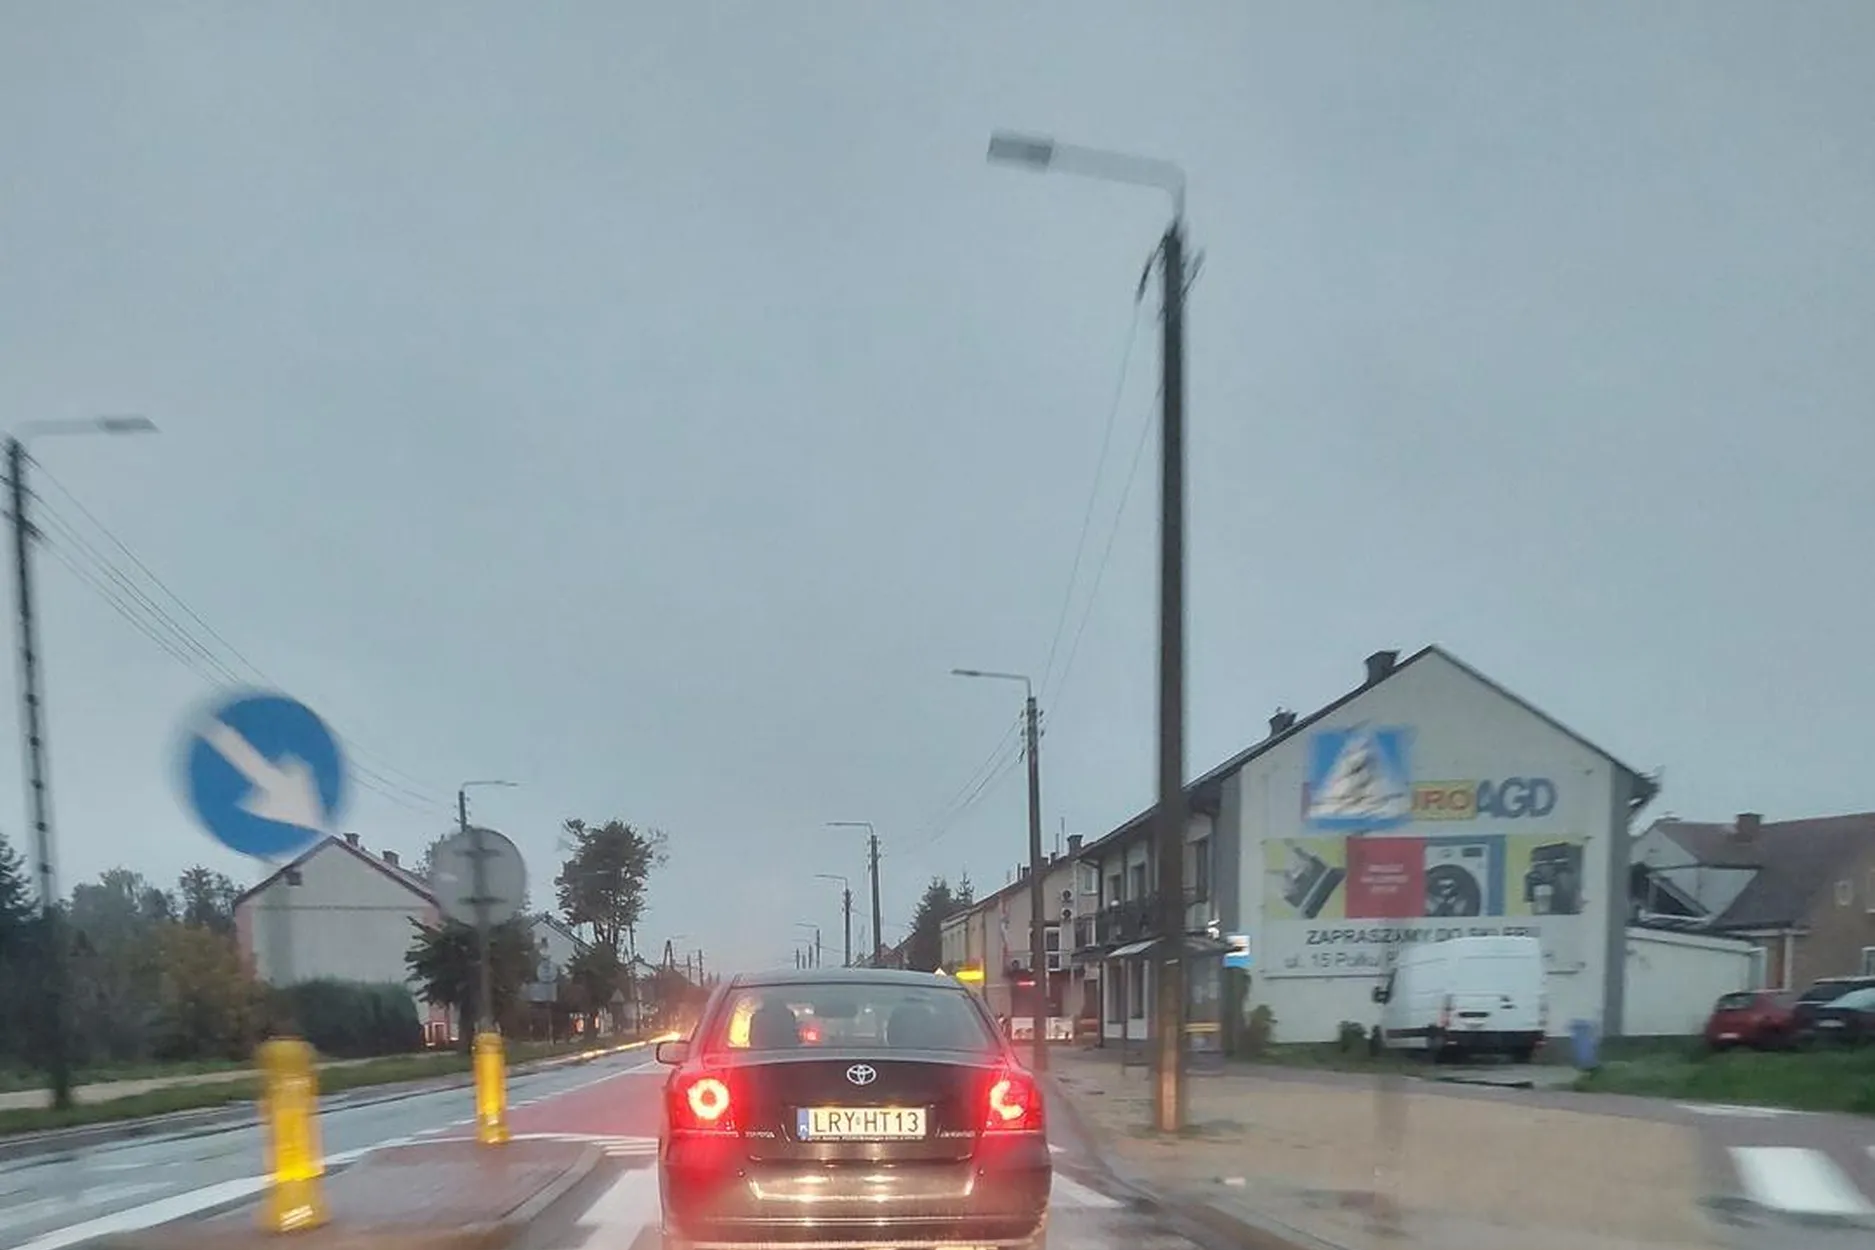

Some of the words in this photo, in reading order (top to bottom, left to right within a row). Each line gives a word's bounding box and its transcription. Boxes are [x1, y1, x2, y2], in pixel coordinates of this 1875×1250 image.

[1477, 776, 1558, 819] AGD
[813, 1110, 856, 1133] LRY
[863, 1110, 920, 1133] HT13
